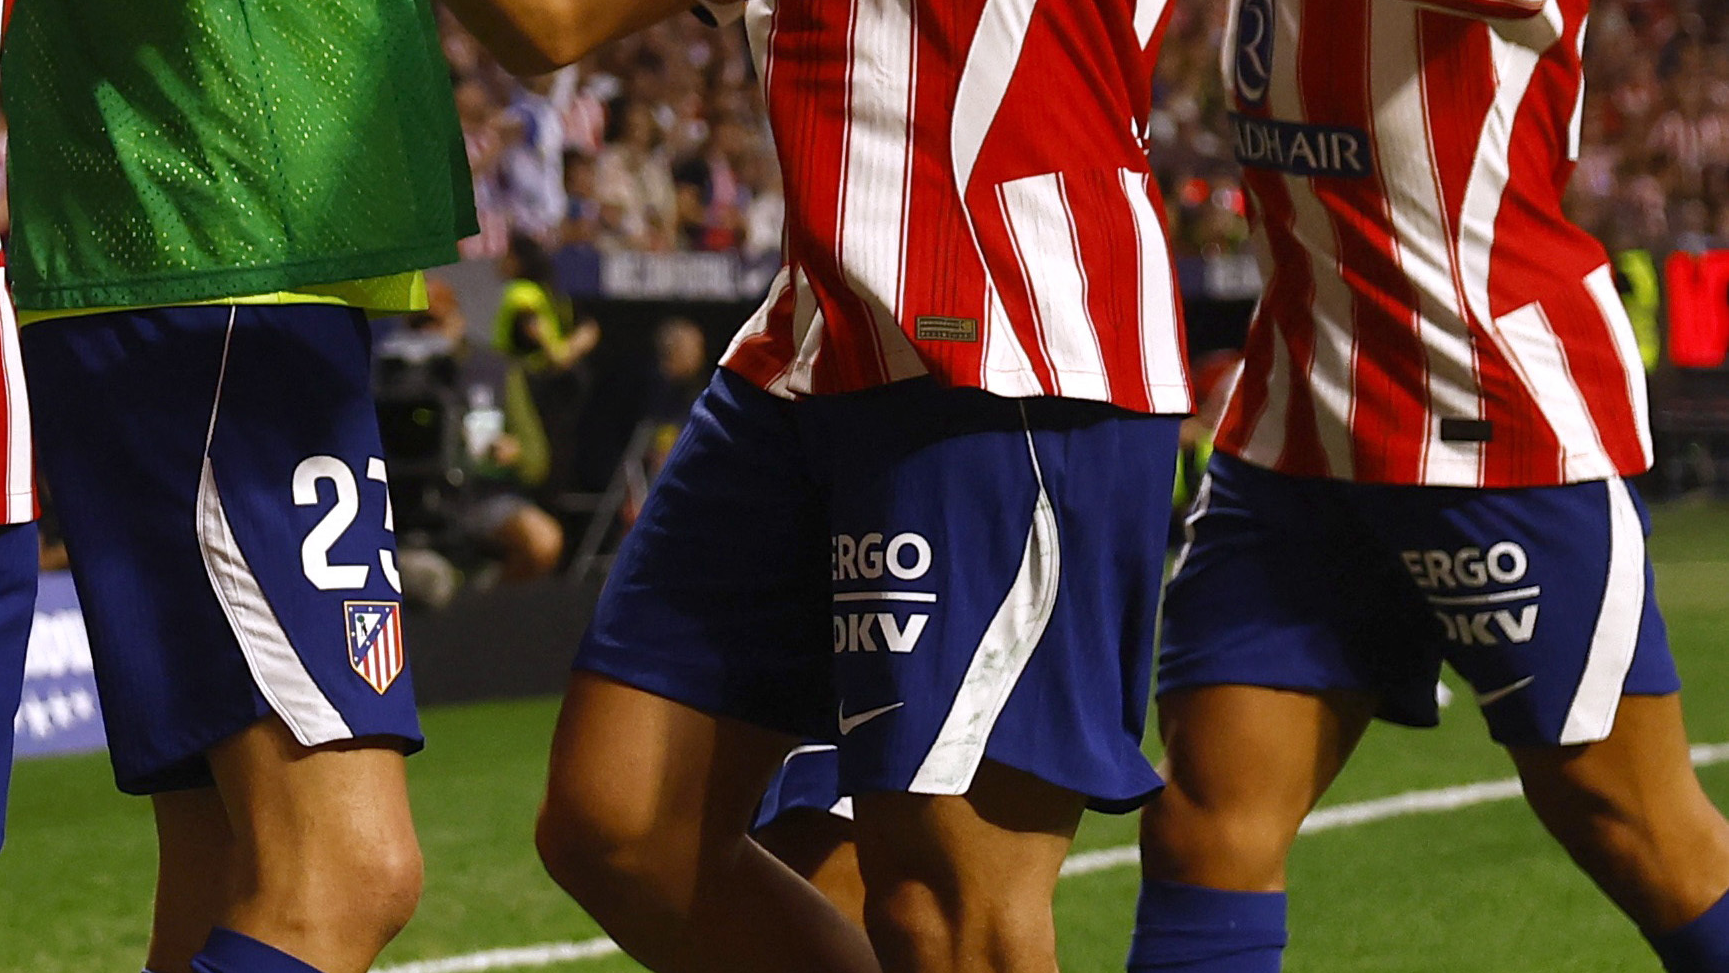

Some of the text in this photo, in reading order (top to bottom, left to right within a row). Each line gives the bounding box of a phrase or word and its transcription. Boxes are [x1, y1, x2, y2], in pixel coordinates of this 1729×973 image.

[1290, 131, 1362, 171] AIR
[831, 532, 932, 581] RGO
[1398, 540, 1528, 589] ERGO
